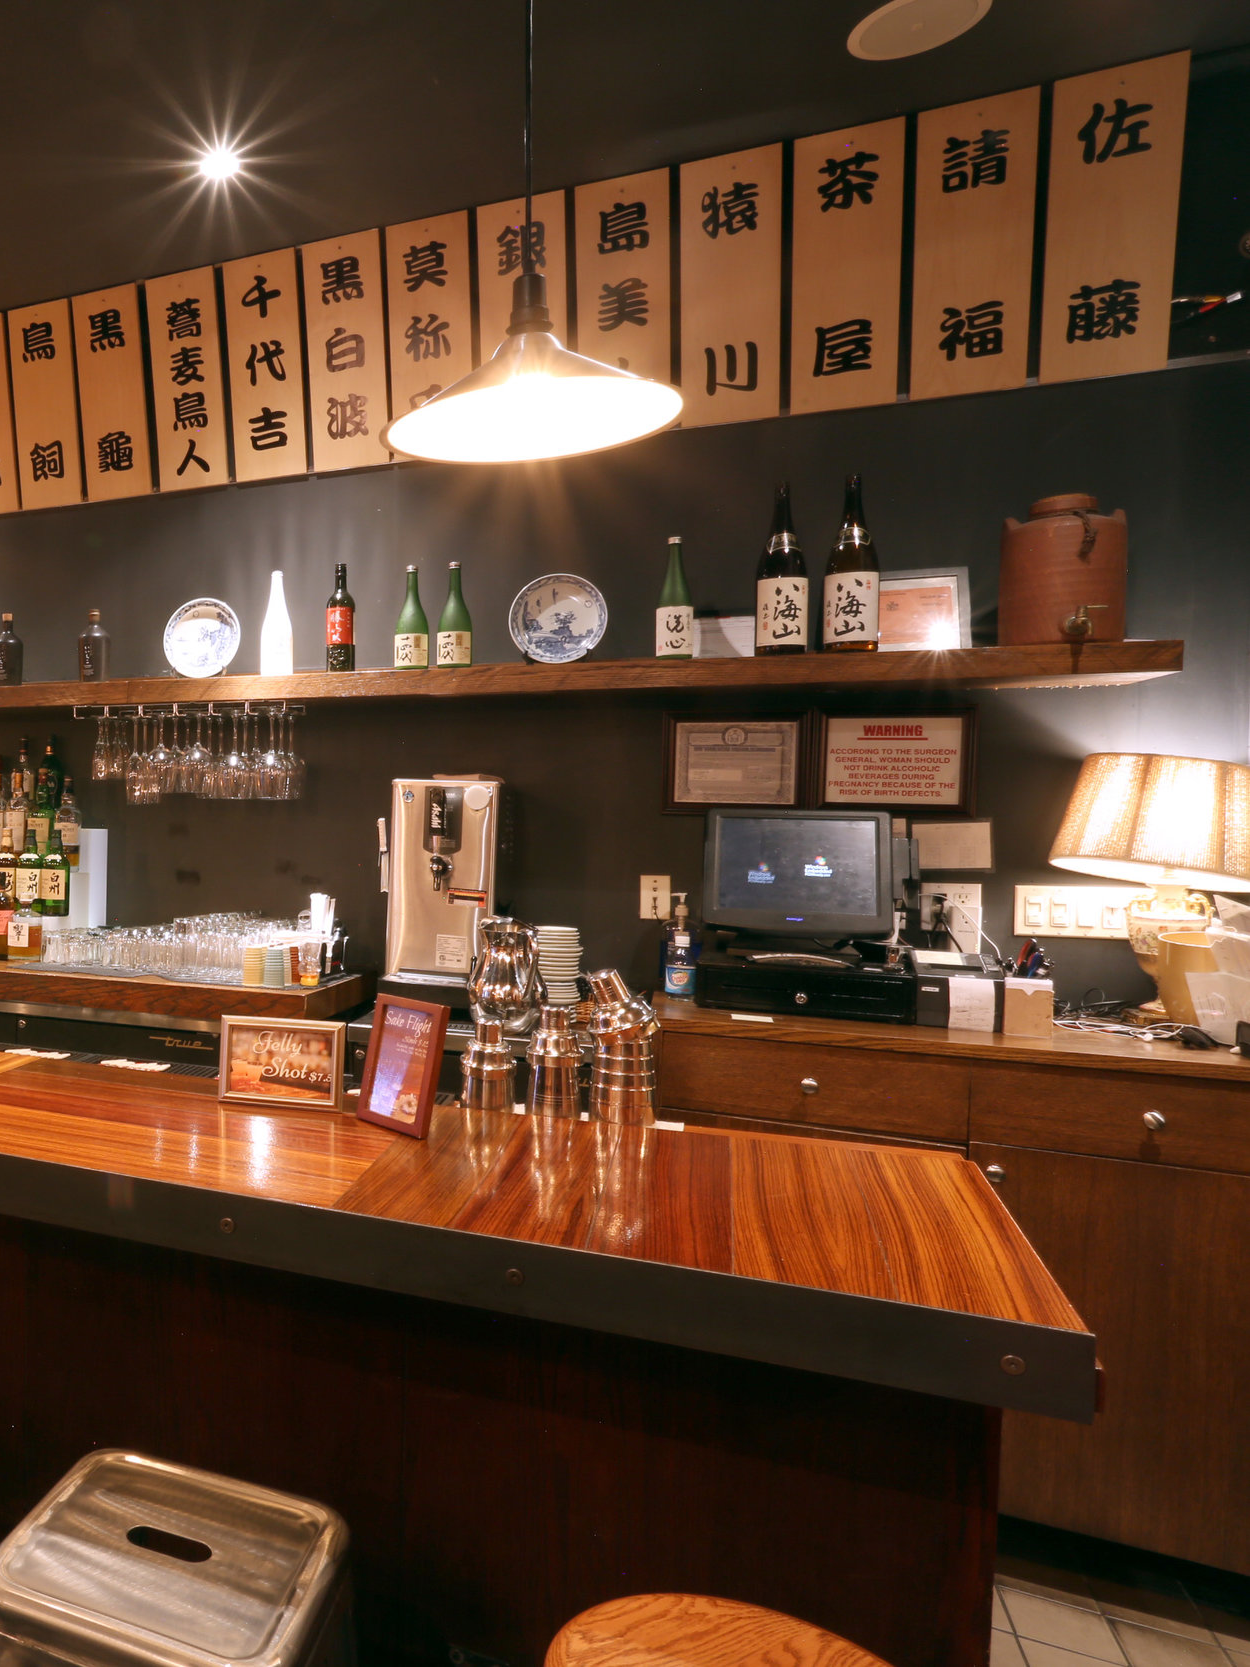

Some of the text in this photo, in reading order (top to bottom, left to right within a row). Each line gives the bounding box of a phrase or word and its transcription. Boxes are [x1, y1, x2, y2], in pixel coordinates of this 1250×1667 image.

[939, 129, 1010, 361] 請福
[1066, 98, 1153, 344] 佐藤
[597, 201, 649, 370] 島美
[701, 182, 759, 396] 猿川
[812, 151, 879, 377] 茶屋
[241, 275, 288, 451] 千代吉
[320, 255, 369, 440] 黒白波
[21, 321, 65, 482] 鳥飼
[772, 583, 802, 639] 八海山
[834, 579, 867, 637] 八海山
[863, 724, 924, 737] WARNING
[914, 748, 957, 756] SURGEON
[828, 780, 879, 788] PREGNANCY
[881, 781, 922, 789] BECAUSE
[431, 803, 442, 828] Asahi
[252, 1030, 303, 1057] Jelly
[384, 1010, 432, 1038] Sake Flight
[261, 1057, 308, 1079] Shot
